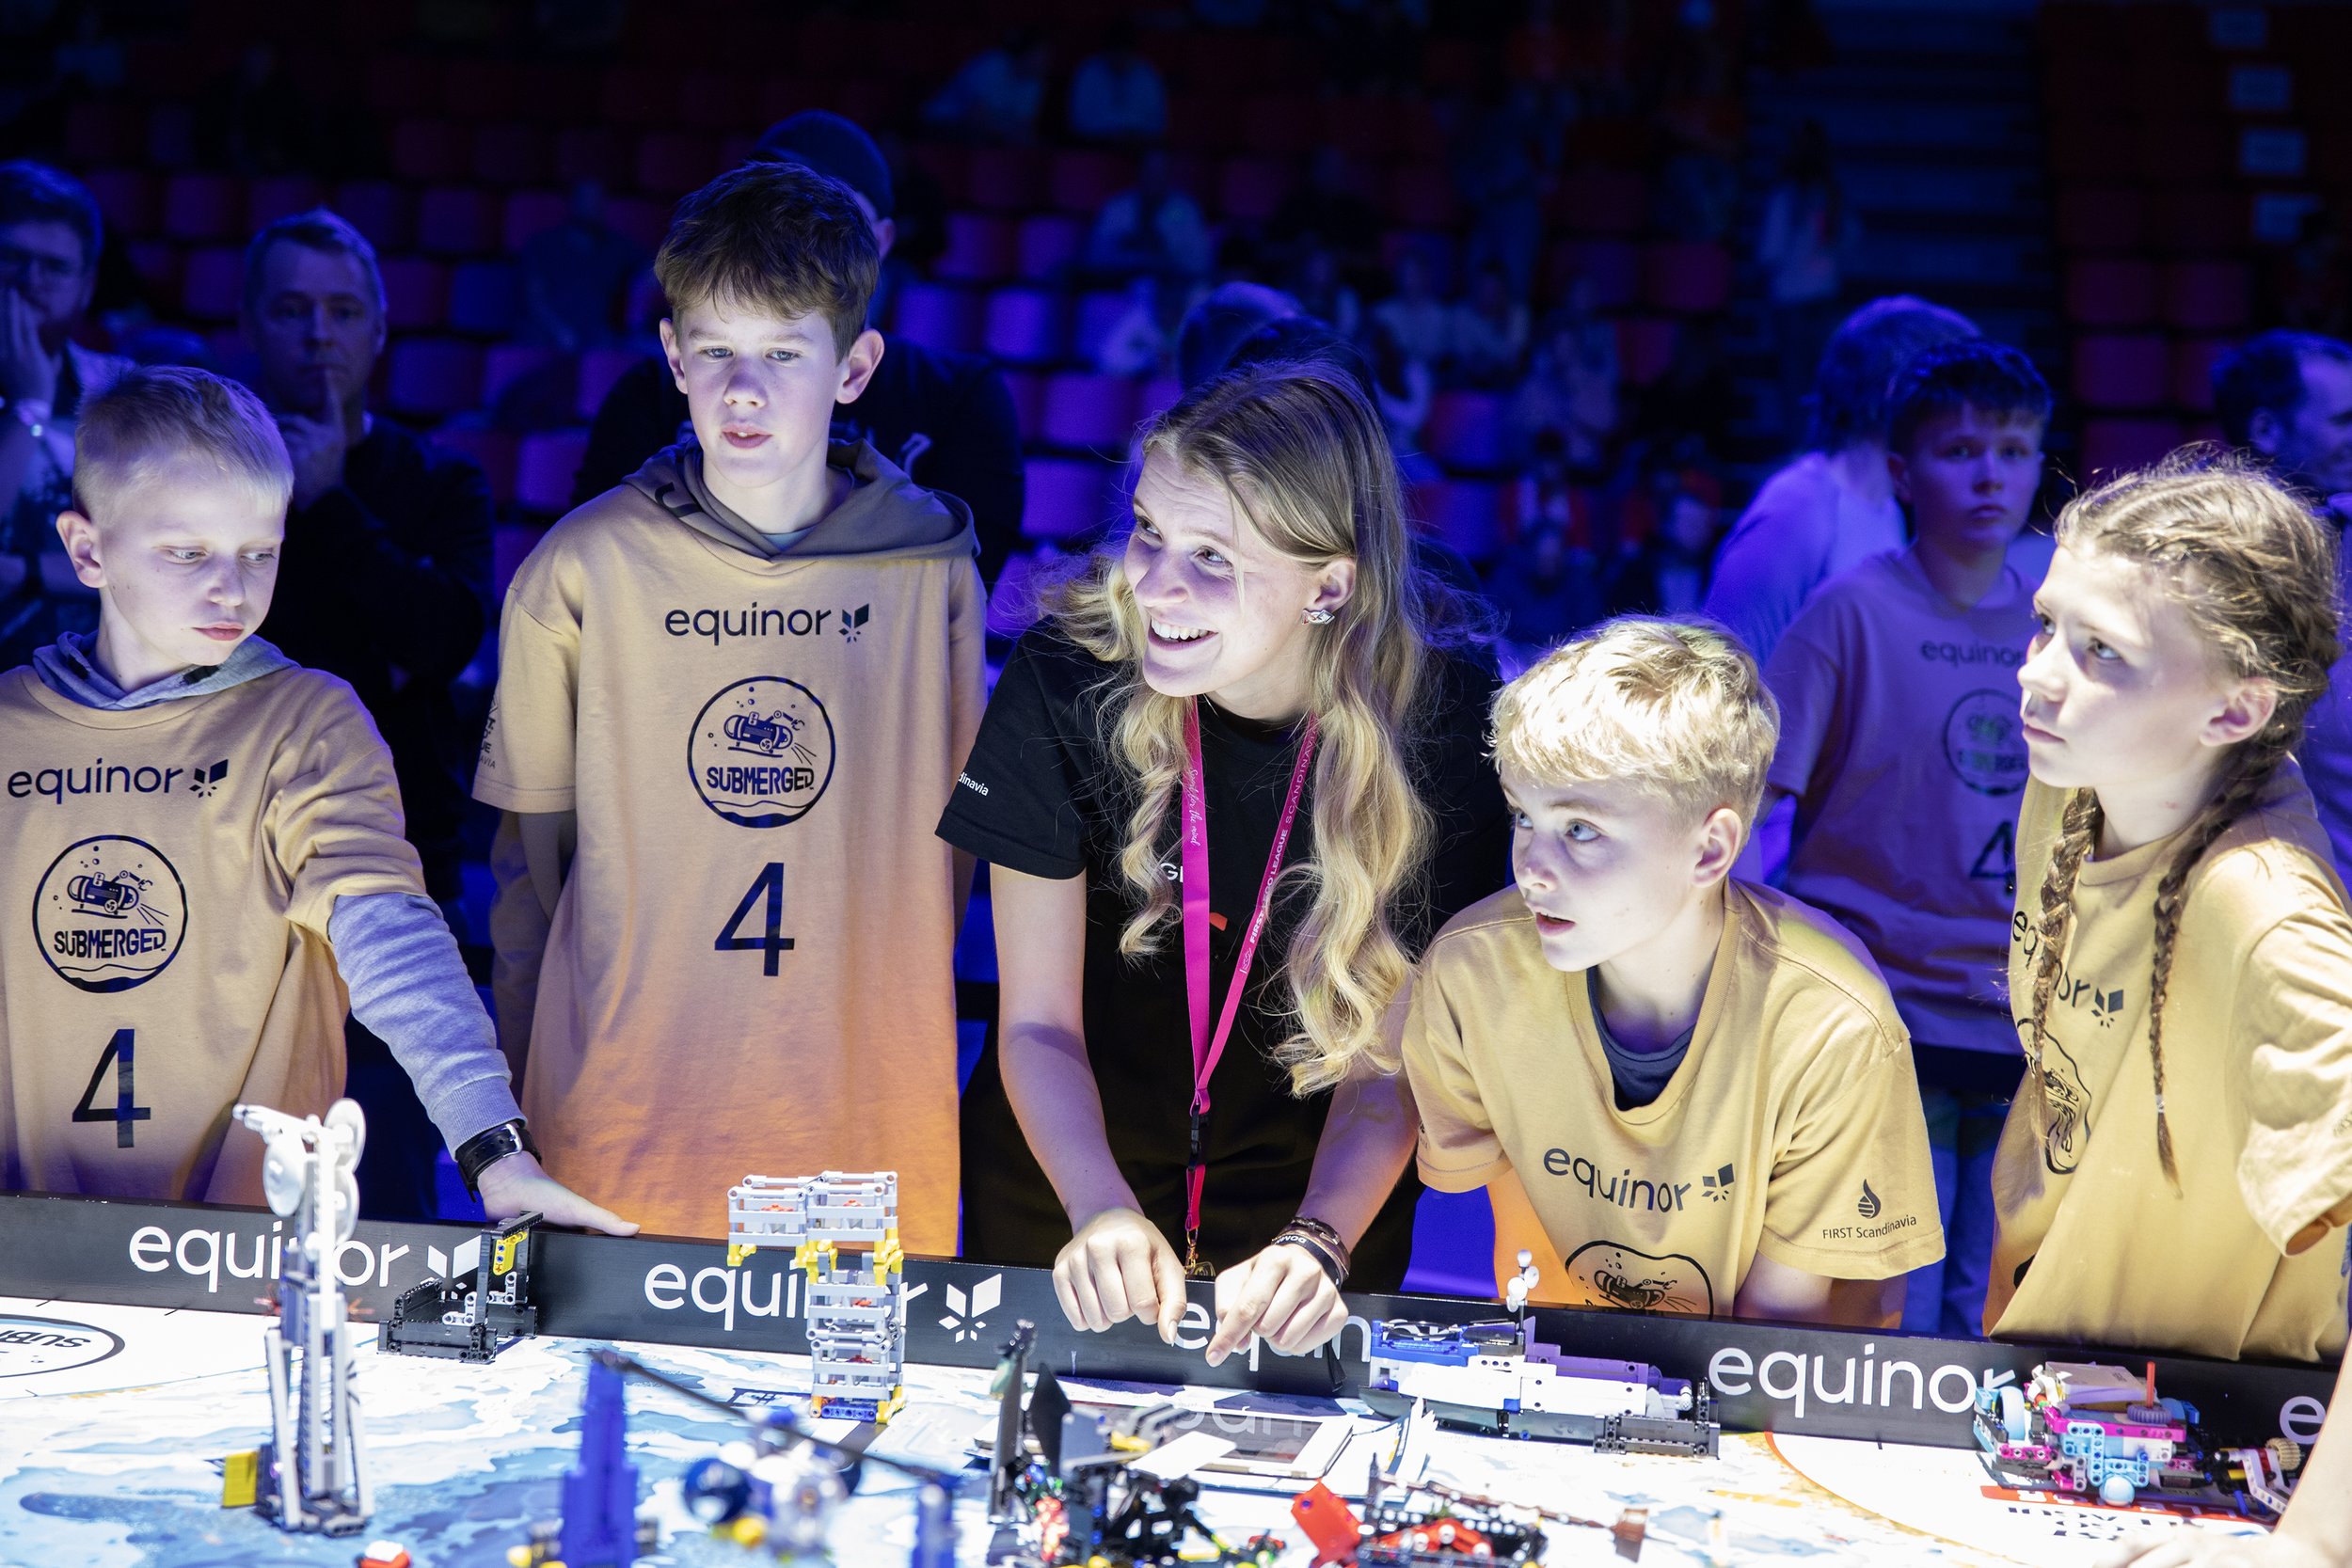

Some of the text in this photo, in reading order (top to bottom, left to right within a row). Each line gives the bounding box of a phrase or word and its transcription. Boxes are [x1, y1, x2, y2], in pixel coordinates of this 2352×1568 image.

[665, 602, 831, 645] equinor
[8, 758, 183, 804] equinor
[707, 767, 814, 795] SUBMERGED
[715, 863, 795, 976] 4
[1249, 910, 1263, 944] FIRST
[1270, 830, 1288, 875] LEAGUE
[54, 927, 167, 958] SUBMERGED
[72, 1028, 151, 1148] 4
[1544, 1148, 1691, 1213] equinor
[129, 1221, 409, 1292] equior
[1822, 1214, 1917, 1239] FIRST Scandinavia
[644, 1259, 928, 1331] equir
